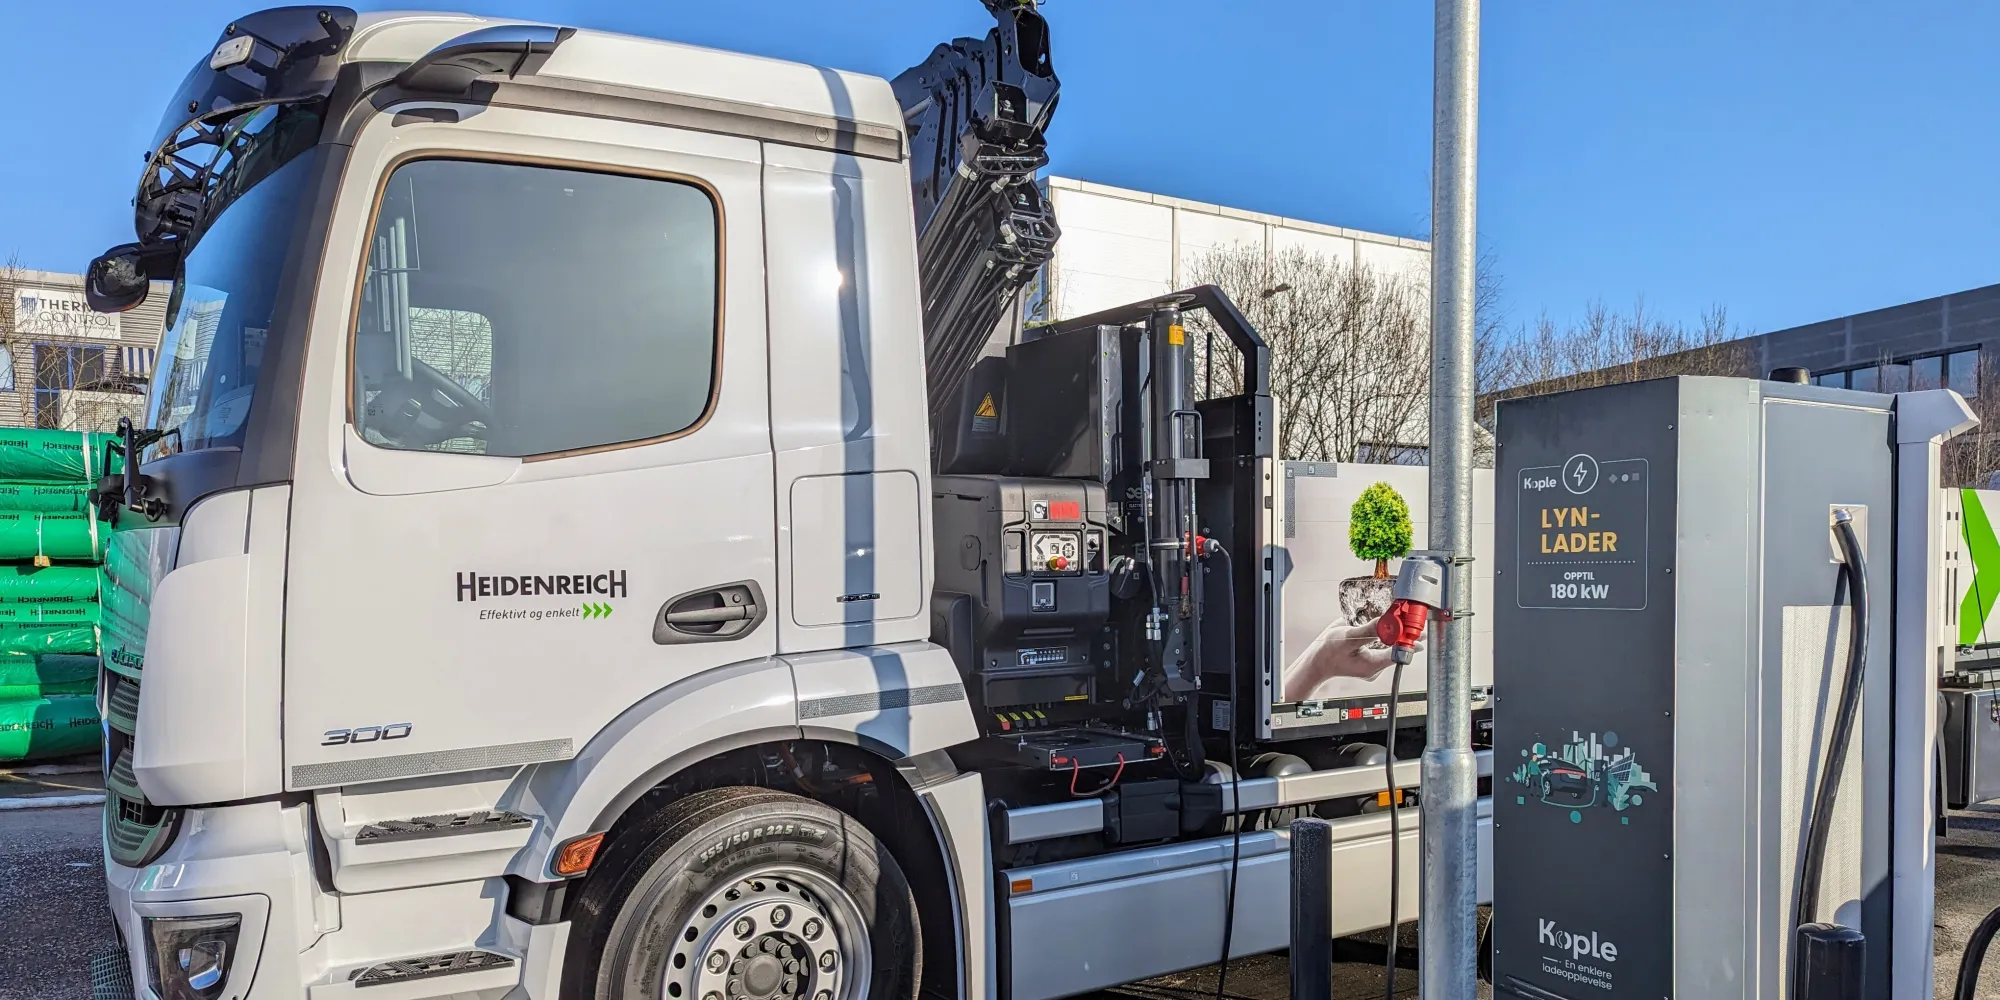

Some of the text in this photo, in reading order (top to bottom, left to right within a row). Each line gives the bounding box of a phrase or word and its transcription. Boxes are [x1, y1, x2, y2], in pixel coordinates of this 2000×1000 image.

[40, 299, 91, 312] THERM
[40, 311, 115, 327] CONTROL
[43, 441, 98, 451] HEDENREICH
[1524, 476, 1557, 491] Kople
[1541, 506, 1600, 529] LYN-
[1541, 532, 1618, 554] LADER
[1563, 571, 1595, 581] OPPTIL
[456, 570, 627, 602] HEIDENREICH
[1550, 583, 1610, 600] 180 kW
[30, 608, 86, 616] HEIDENREIH
[479, 607, 579, 620] Effektivt og enkelt
[320, 722, 413, 746] 300
[753, 827, 763, 839] R
[766, 824, 794, 836] 22.5
[1538, 917, 1618, 962] Kople
[1542, 962, 1613, 990] ladeopplevelse
[1565, 959, 1613, 980] En enklere
